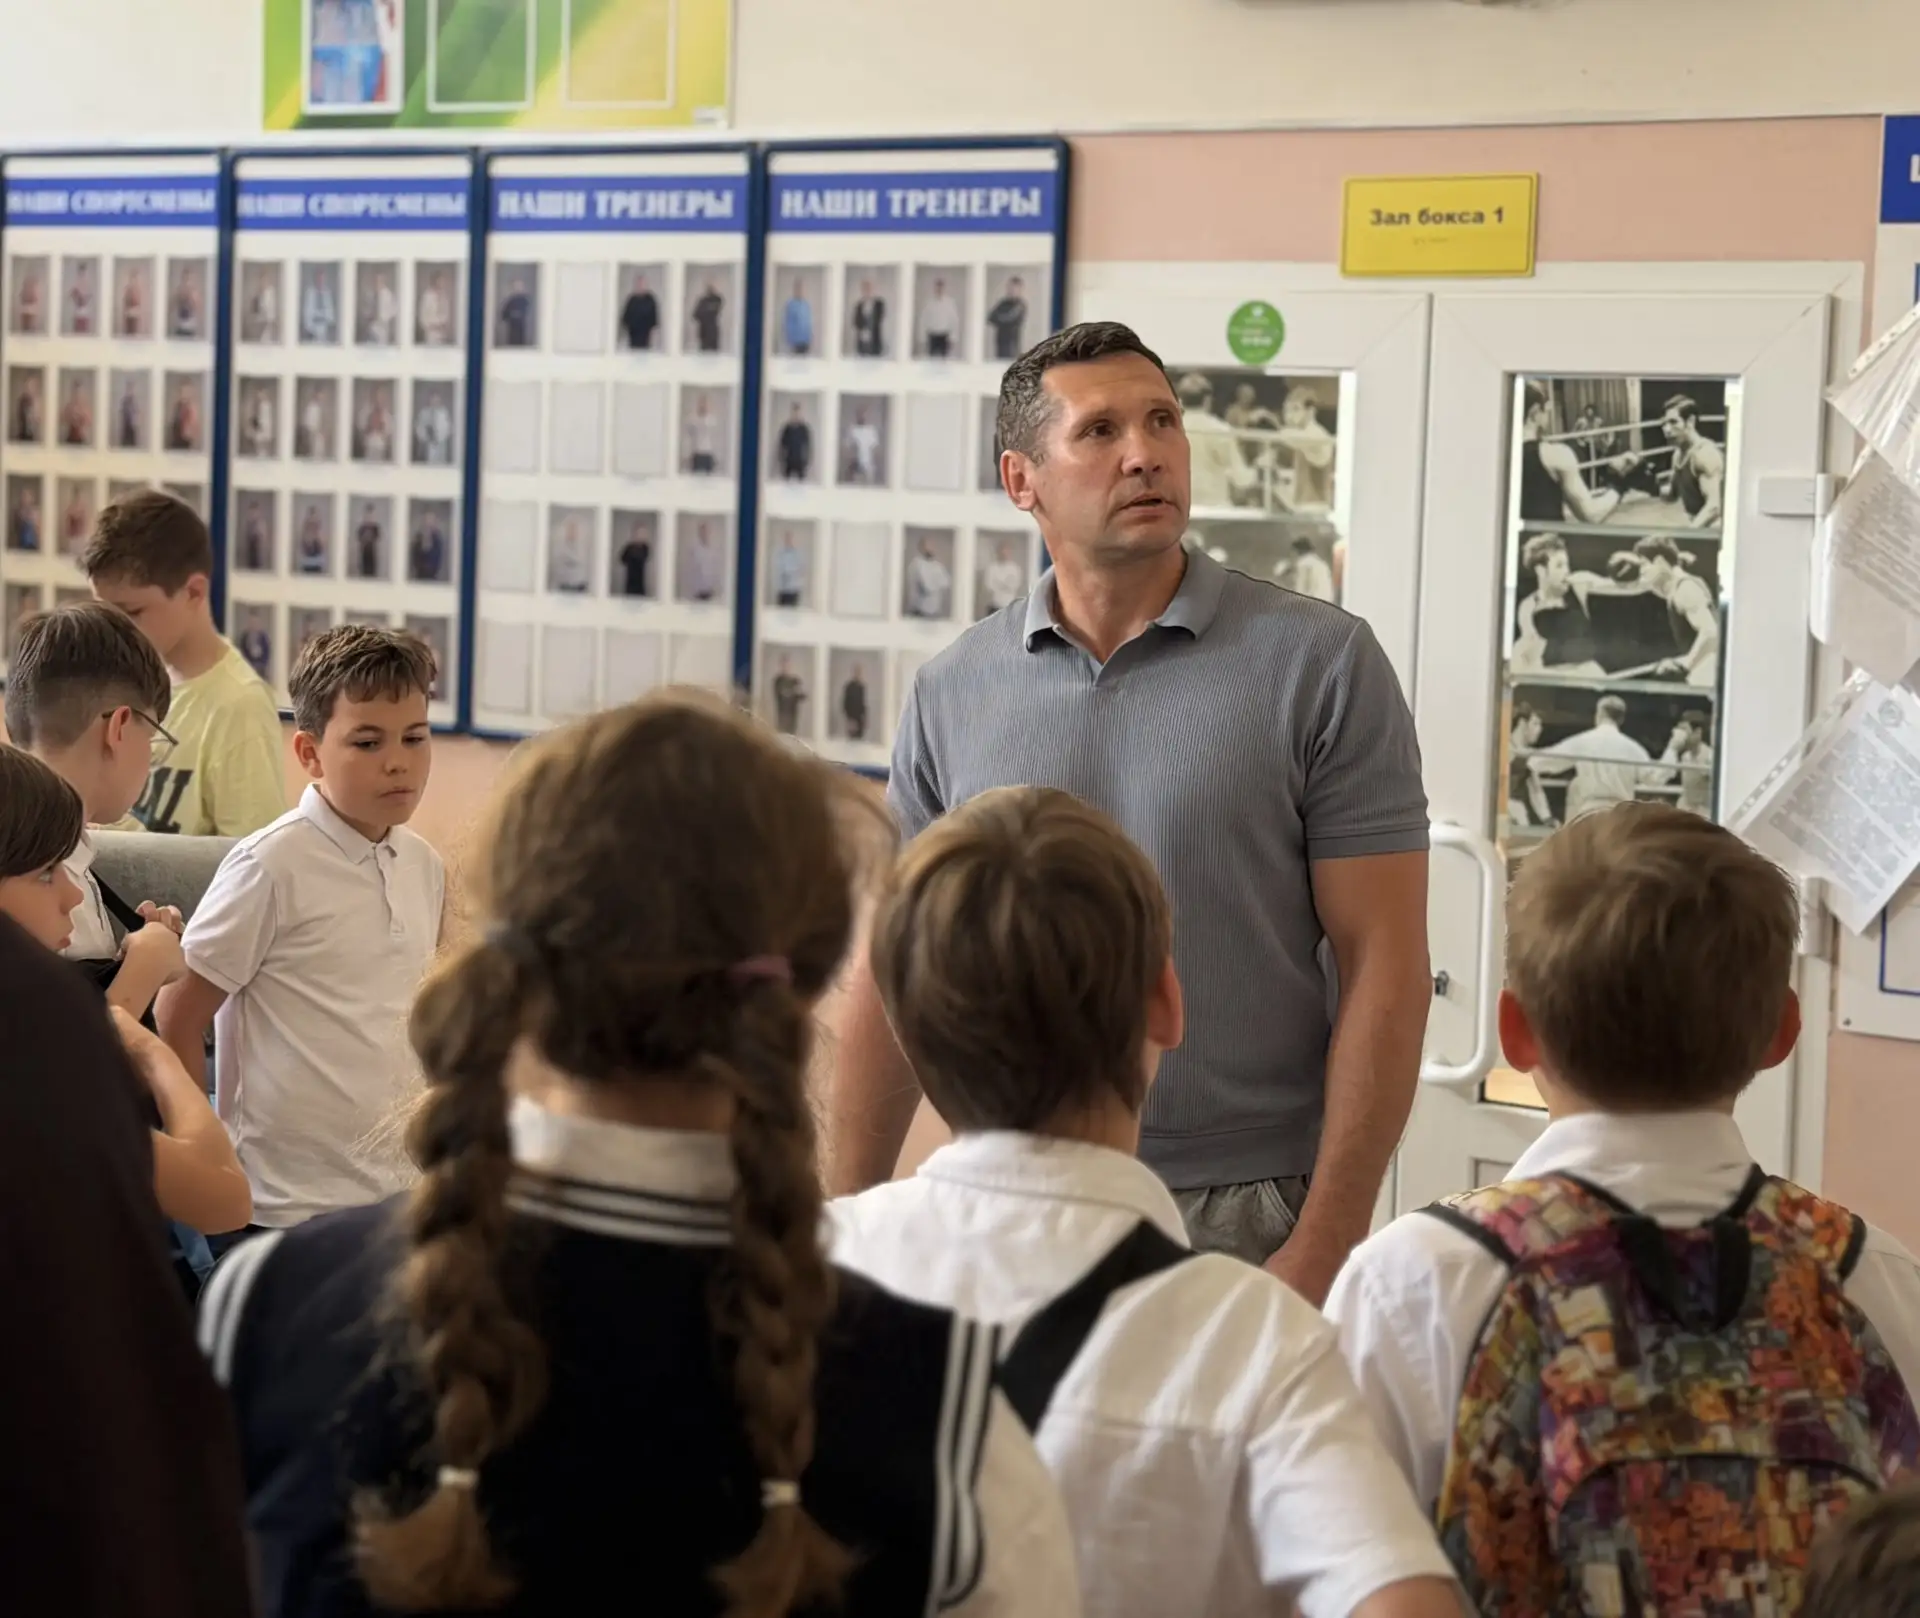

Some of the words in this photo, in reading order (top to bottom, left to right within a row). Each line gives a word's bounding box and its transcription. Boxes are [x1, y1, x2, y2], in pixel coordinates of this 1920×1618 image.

[498, 190, 587, 219] НАШИ
[593, 189, 734, 218] ТРЕНЕРЫ
[780, 189, 878, 218] НАШИ
[887, 187, 1042, 217] ТРЕНЕРЫ
[1369, 207, 1411, 226] Зал
[1417, 206, 1486, 225] бокса
[1492, 205, 1504, 224] 1
